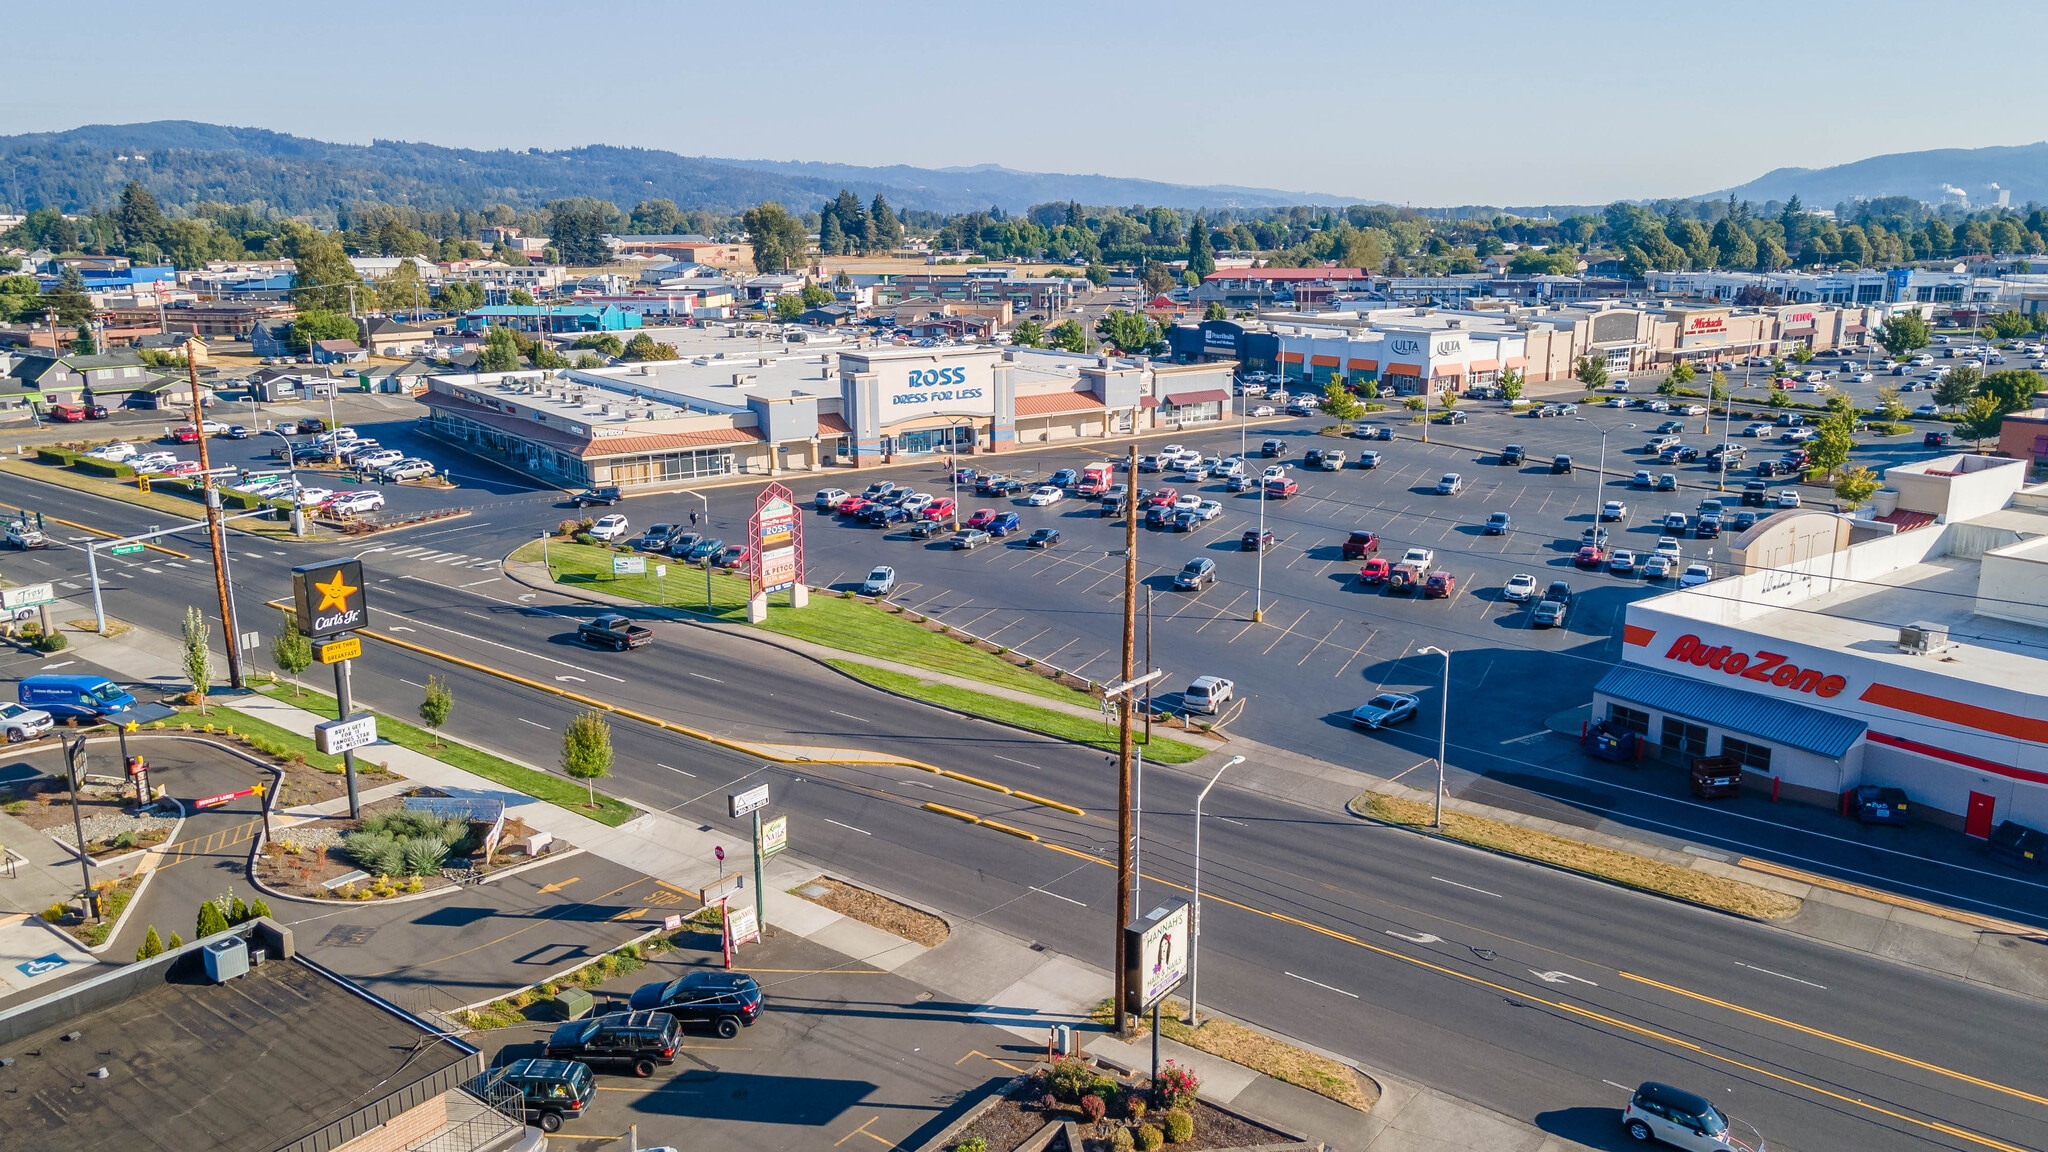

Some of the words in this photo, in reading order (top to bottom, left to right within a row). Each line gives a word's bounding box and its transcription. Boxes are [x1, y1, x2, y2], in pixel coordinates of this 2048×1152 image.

[1691, 317, 1723, 330] Michaels
[1395, 340, 1419, 352] ULTA
[1440, 341, 1461, 352] ULTA
[909, 367, 966, 388] ROSS
[893, 392, 929, 405] DRESS
[931, 390, 953, 402] FOR
[956, 388, 982, 400] LESS
[595, 426, 629, 438] verizon
[766, 524, 788, 535] ROSS
[771, 563, 794, 574] PETCO
[17, 588, 44, 603] Troy
[315, 612, 344, 631] Carl's
[344, 609, 359, 624] Jr.
[326, 643, 342, 652] DRIVE
[343, 640, 357, 649] THRU
[327, 649, 358, 661] BREAKFAST
[1664, 634, 1847, 698] AutoZone
[335, 728, 346, 736] BUY
[333, 736, 354, 747] FAMOUS
[356, 731, 370, 740] STAR
[346, 738, 369, 748] WESTERN
[643, 890, 683, 907] STOP
[1146, 914, 1183, 947] HANNAH'S
[1147, 973, 1161, 988] HAIR
[1166, 956, 1182, 973] NAILS
